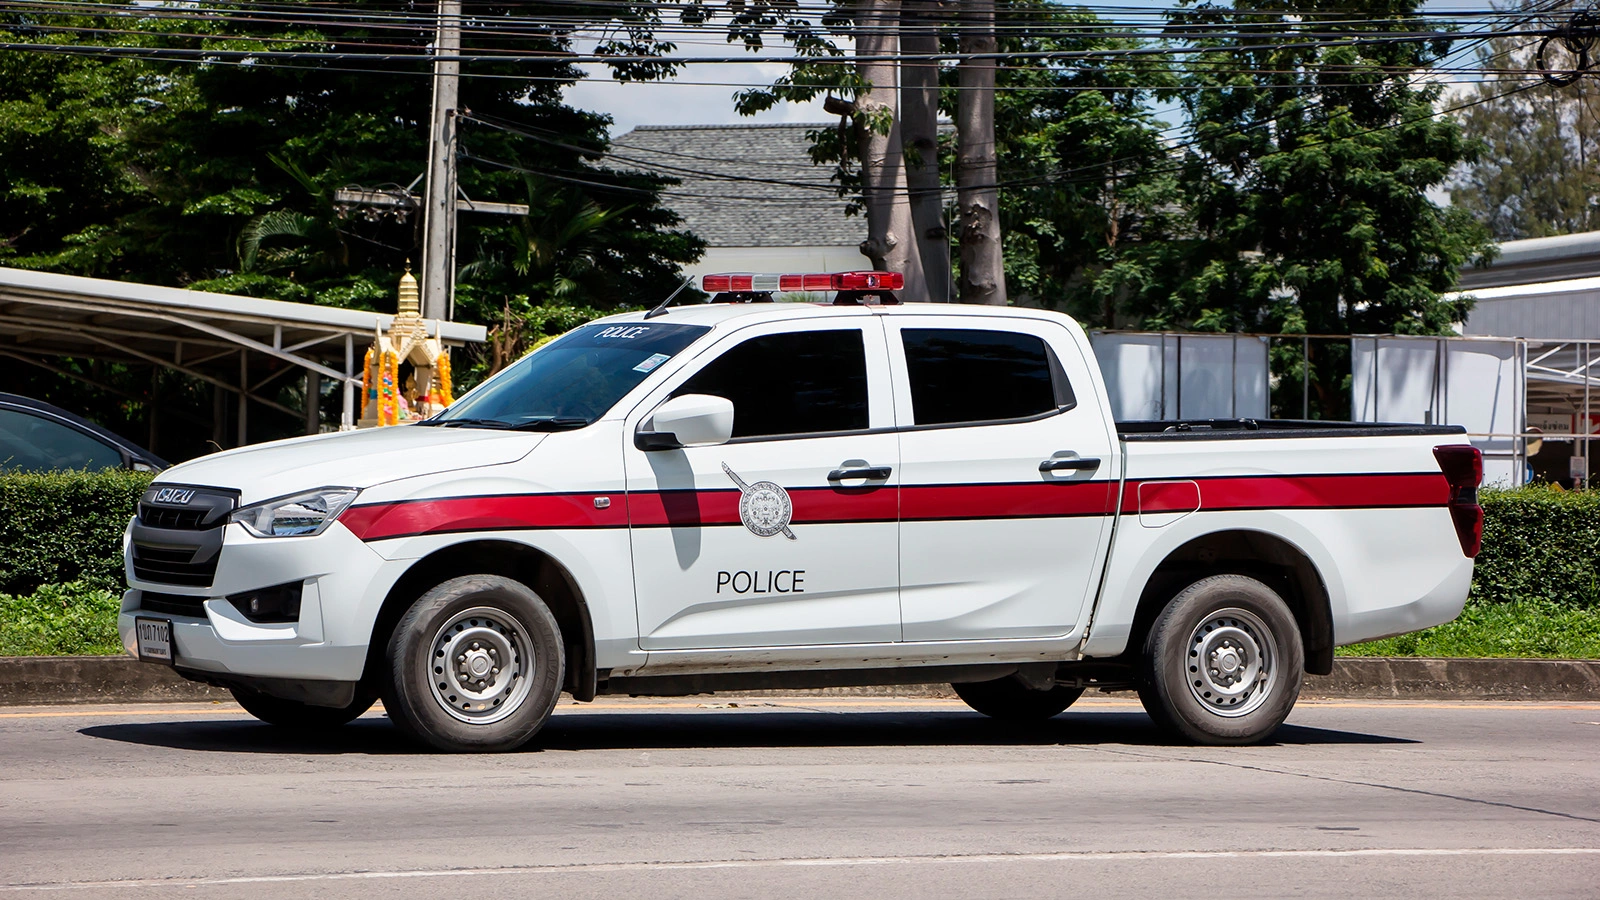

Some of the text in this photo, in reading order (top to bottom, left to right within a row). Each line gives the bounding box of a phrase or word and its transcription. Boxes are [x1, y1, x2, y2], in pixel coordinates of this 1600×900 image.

[593, 326, 650, 339] POLICE
[151, 488, 196, 504] ISUZU
[716, 570, 806, 593] POLICE
